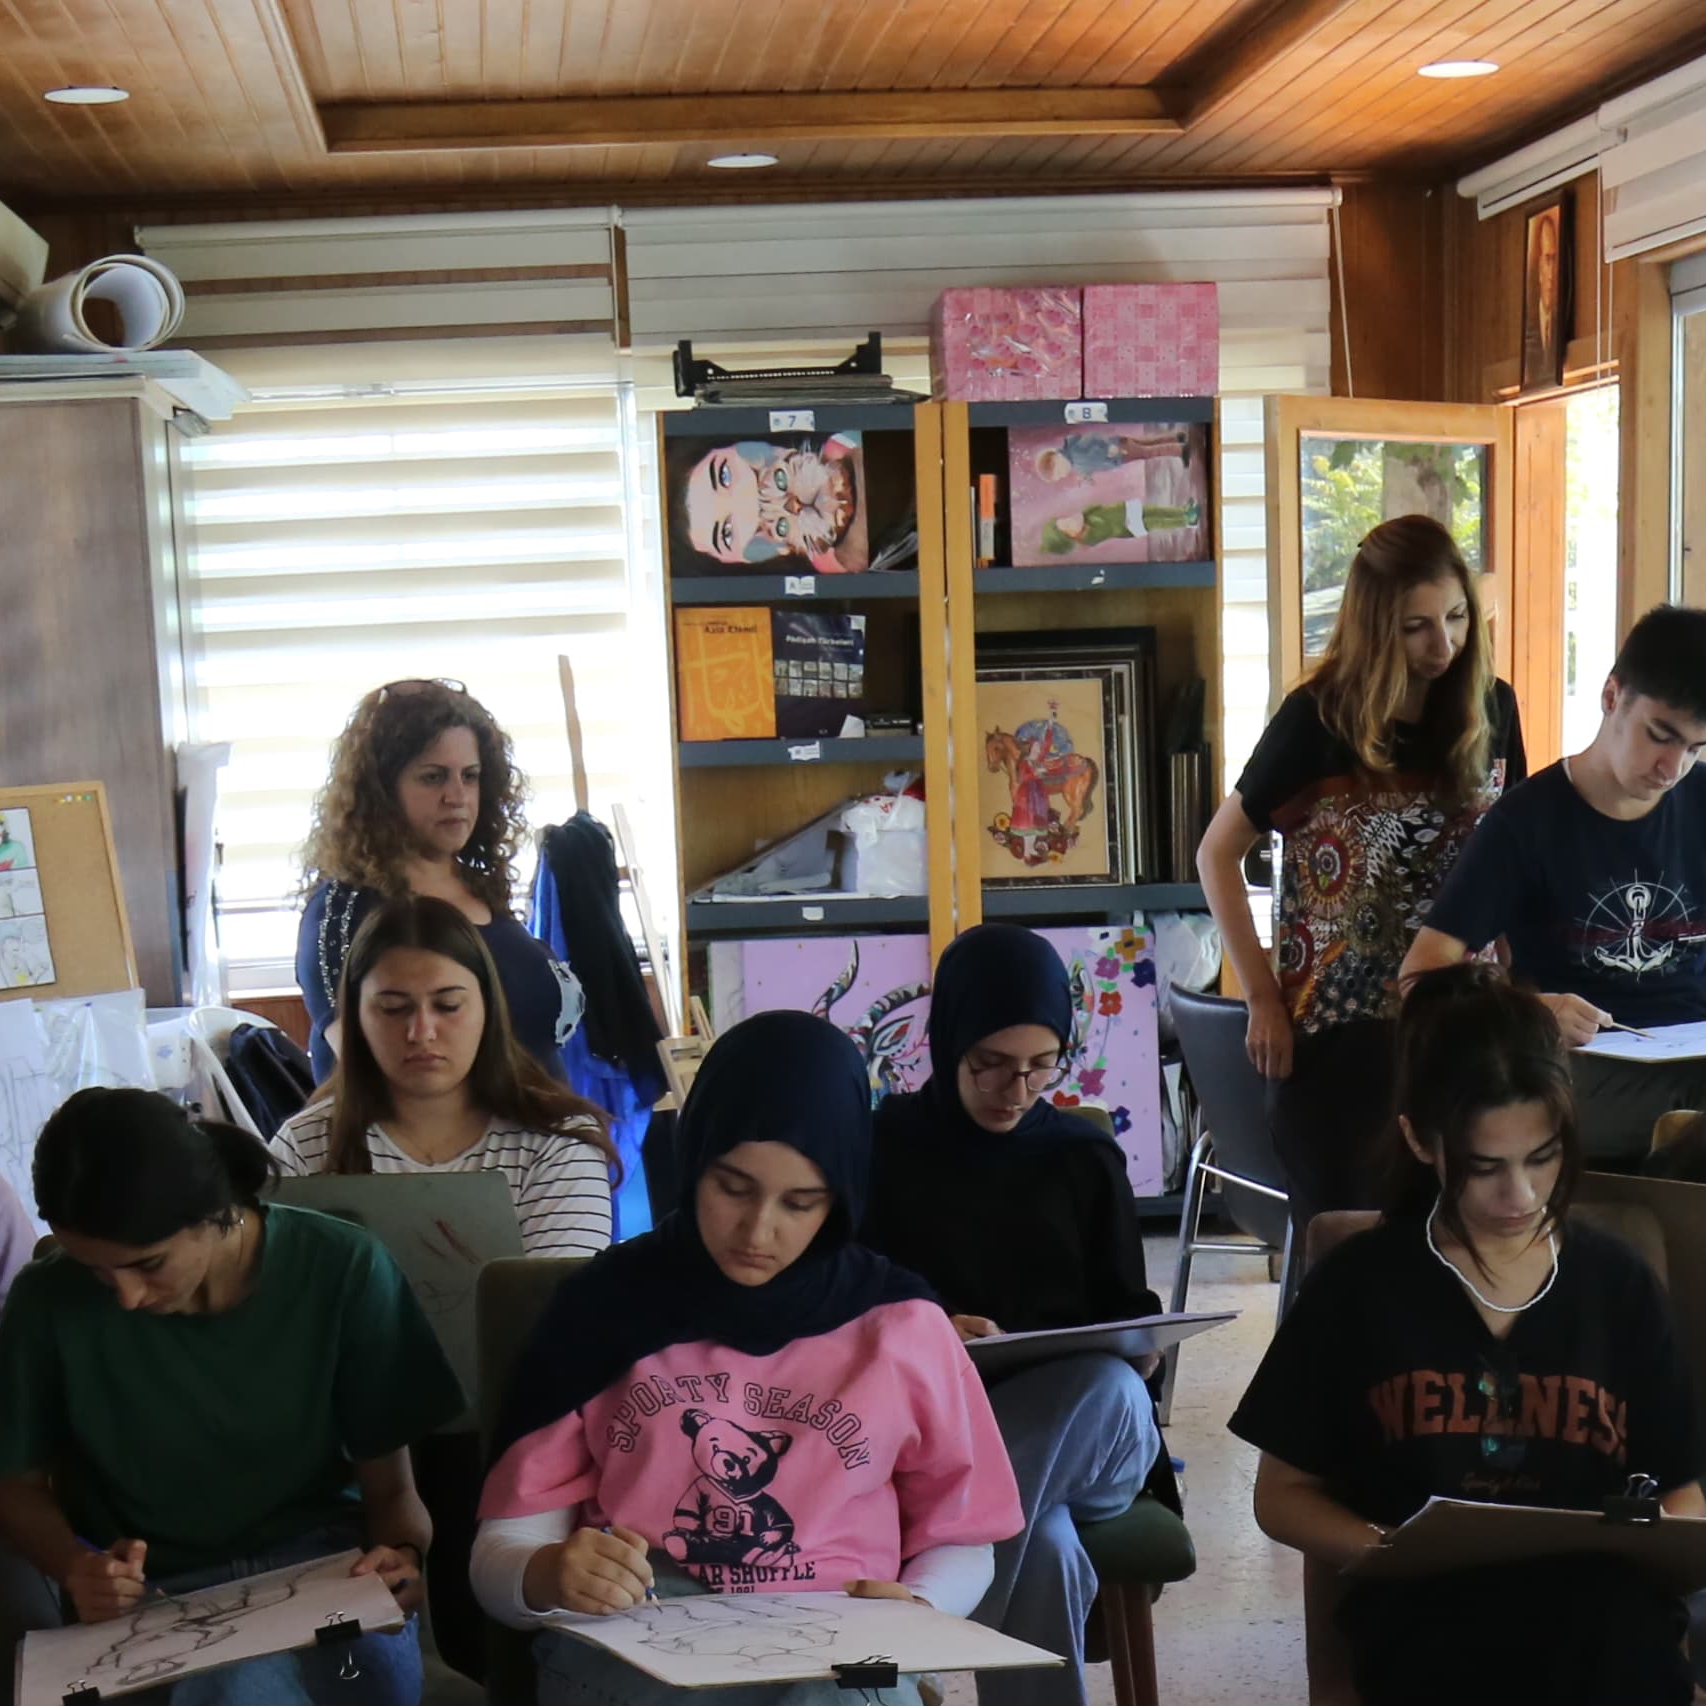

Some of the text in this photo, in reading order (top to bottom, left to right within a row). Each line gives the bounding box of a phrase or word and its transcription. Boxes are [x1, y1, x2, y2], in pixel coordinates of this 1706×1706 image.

[788, 415, 797, 428] 7
[606, 1372, 870, 1471] SPORTY SEASON
[712, 1504, 756, 1536] 91
[729, 1560, 816, 1586] SHUFFLE
